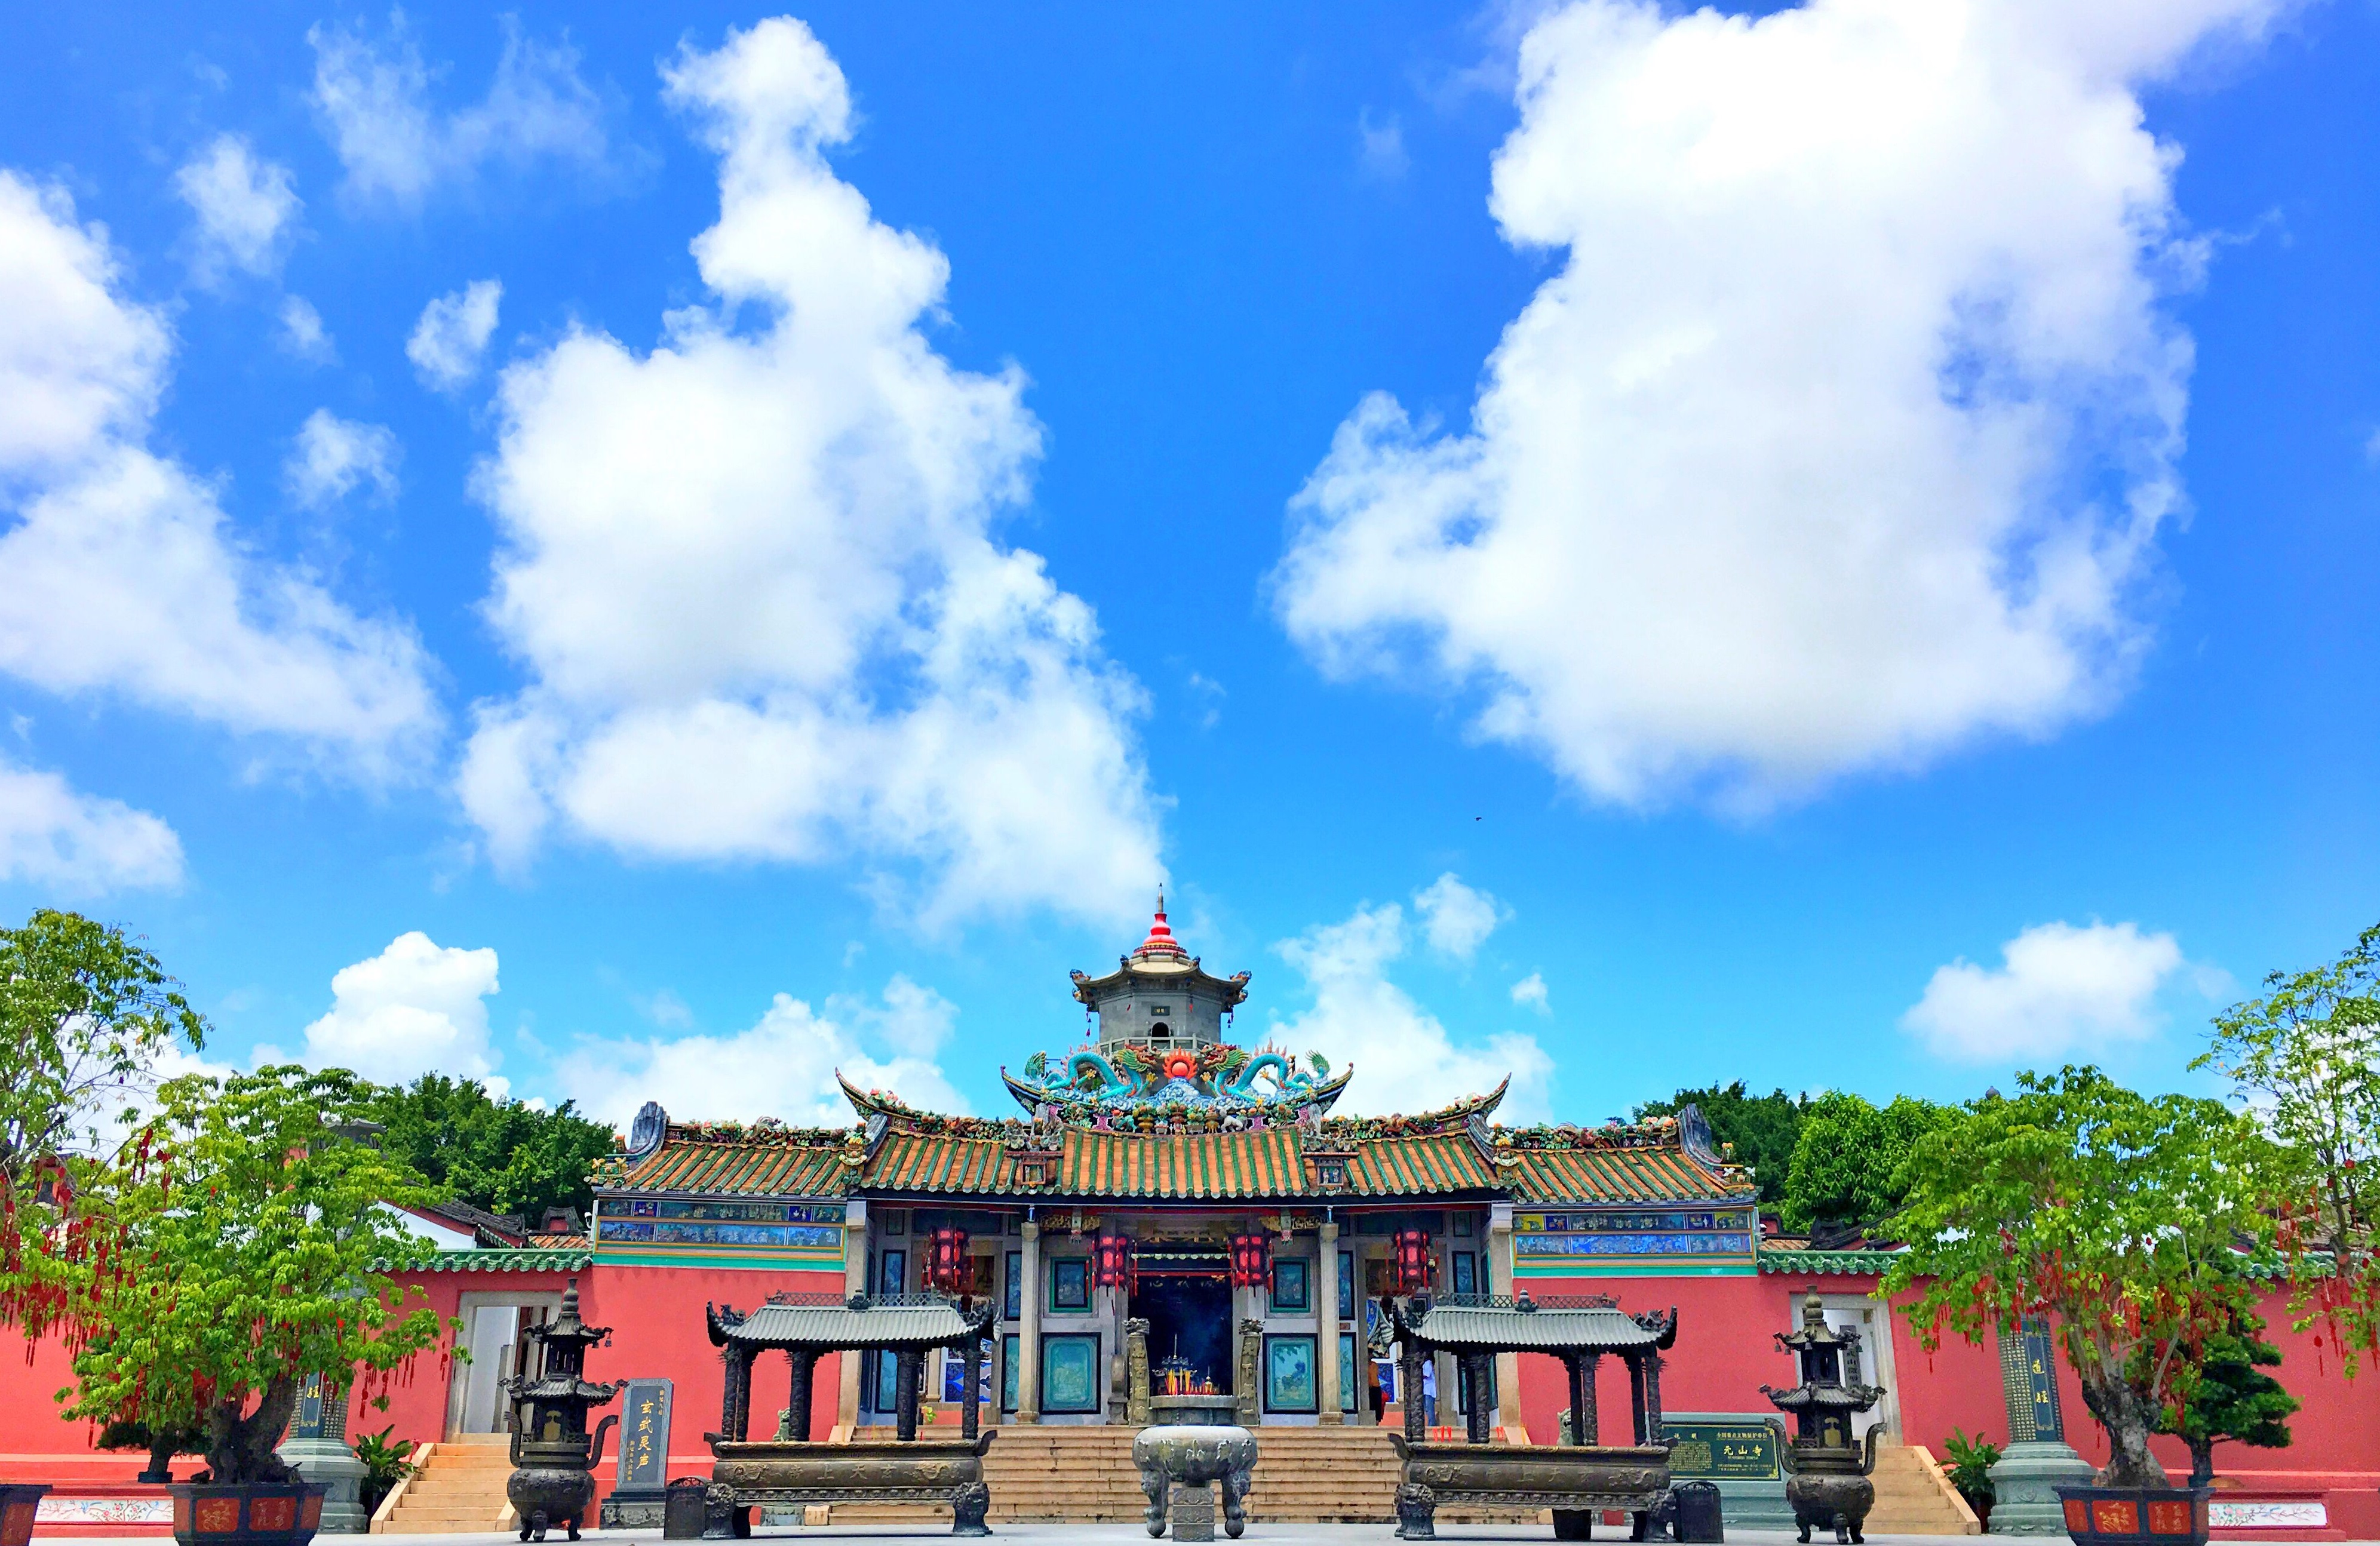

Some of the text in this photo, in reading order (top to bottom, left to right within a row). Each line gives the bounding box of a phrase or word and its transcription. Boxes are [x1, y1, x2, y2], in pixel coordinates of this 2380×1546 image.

[635, 1399, 655, 1470] 玄武灵声
[1723, 1444, 1763, 1456] 元山寺
